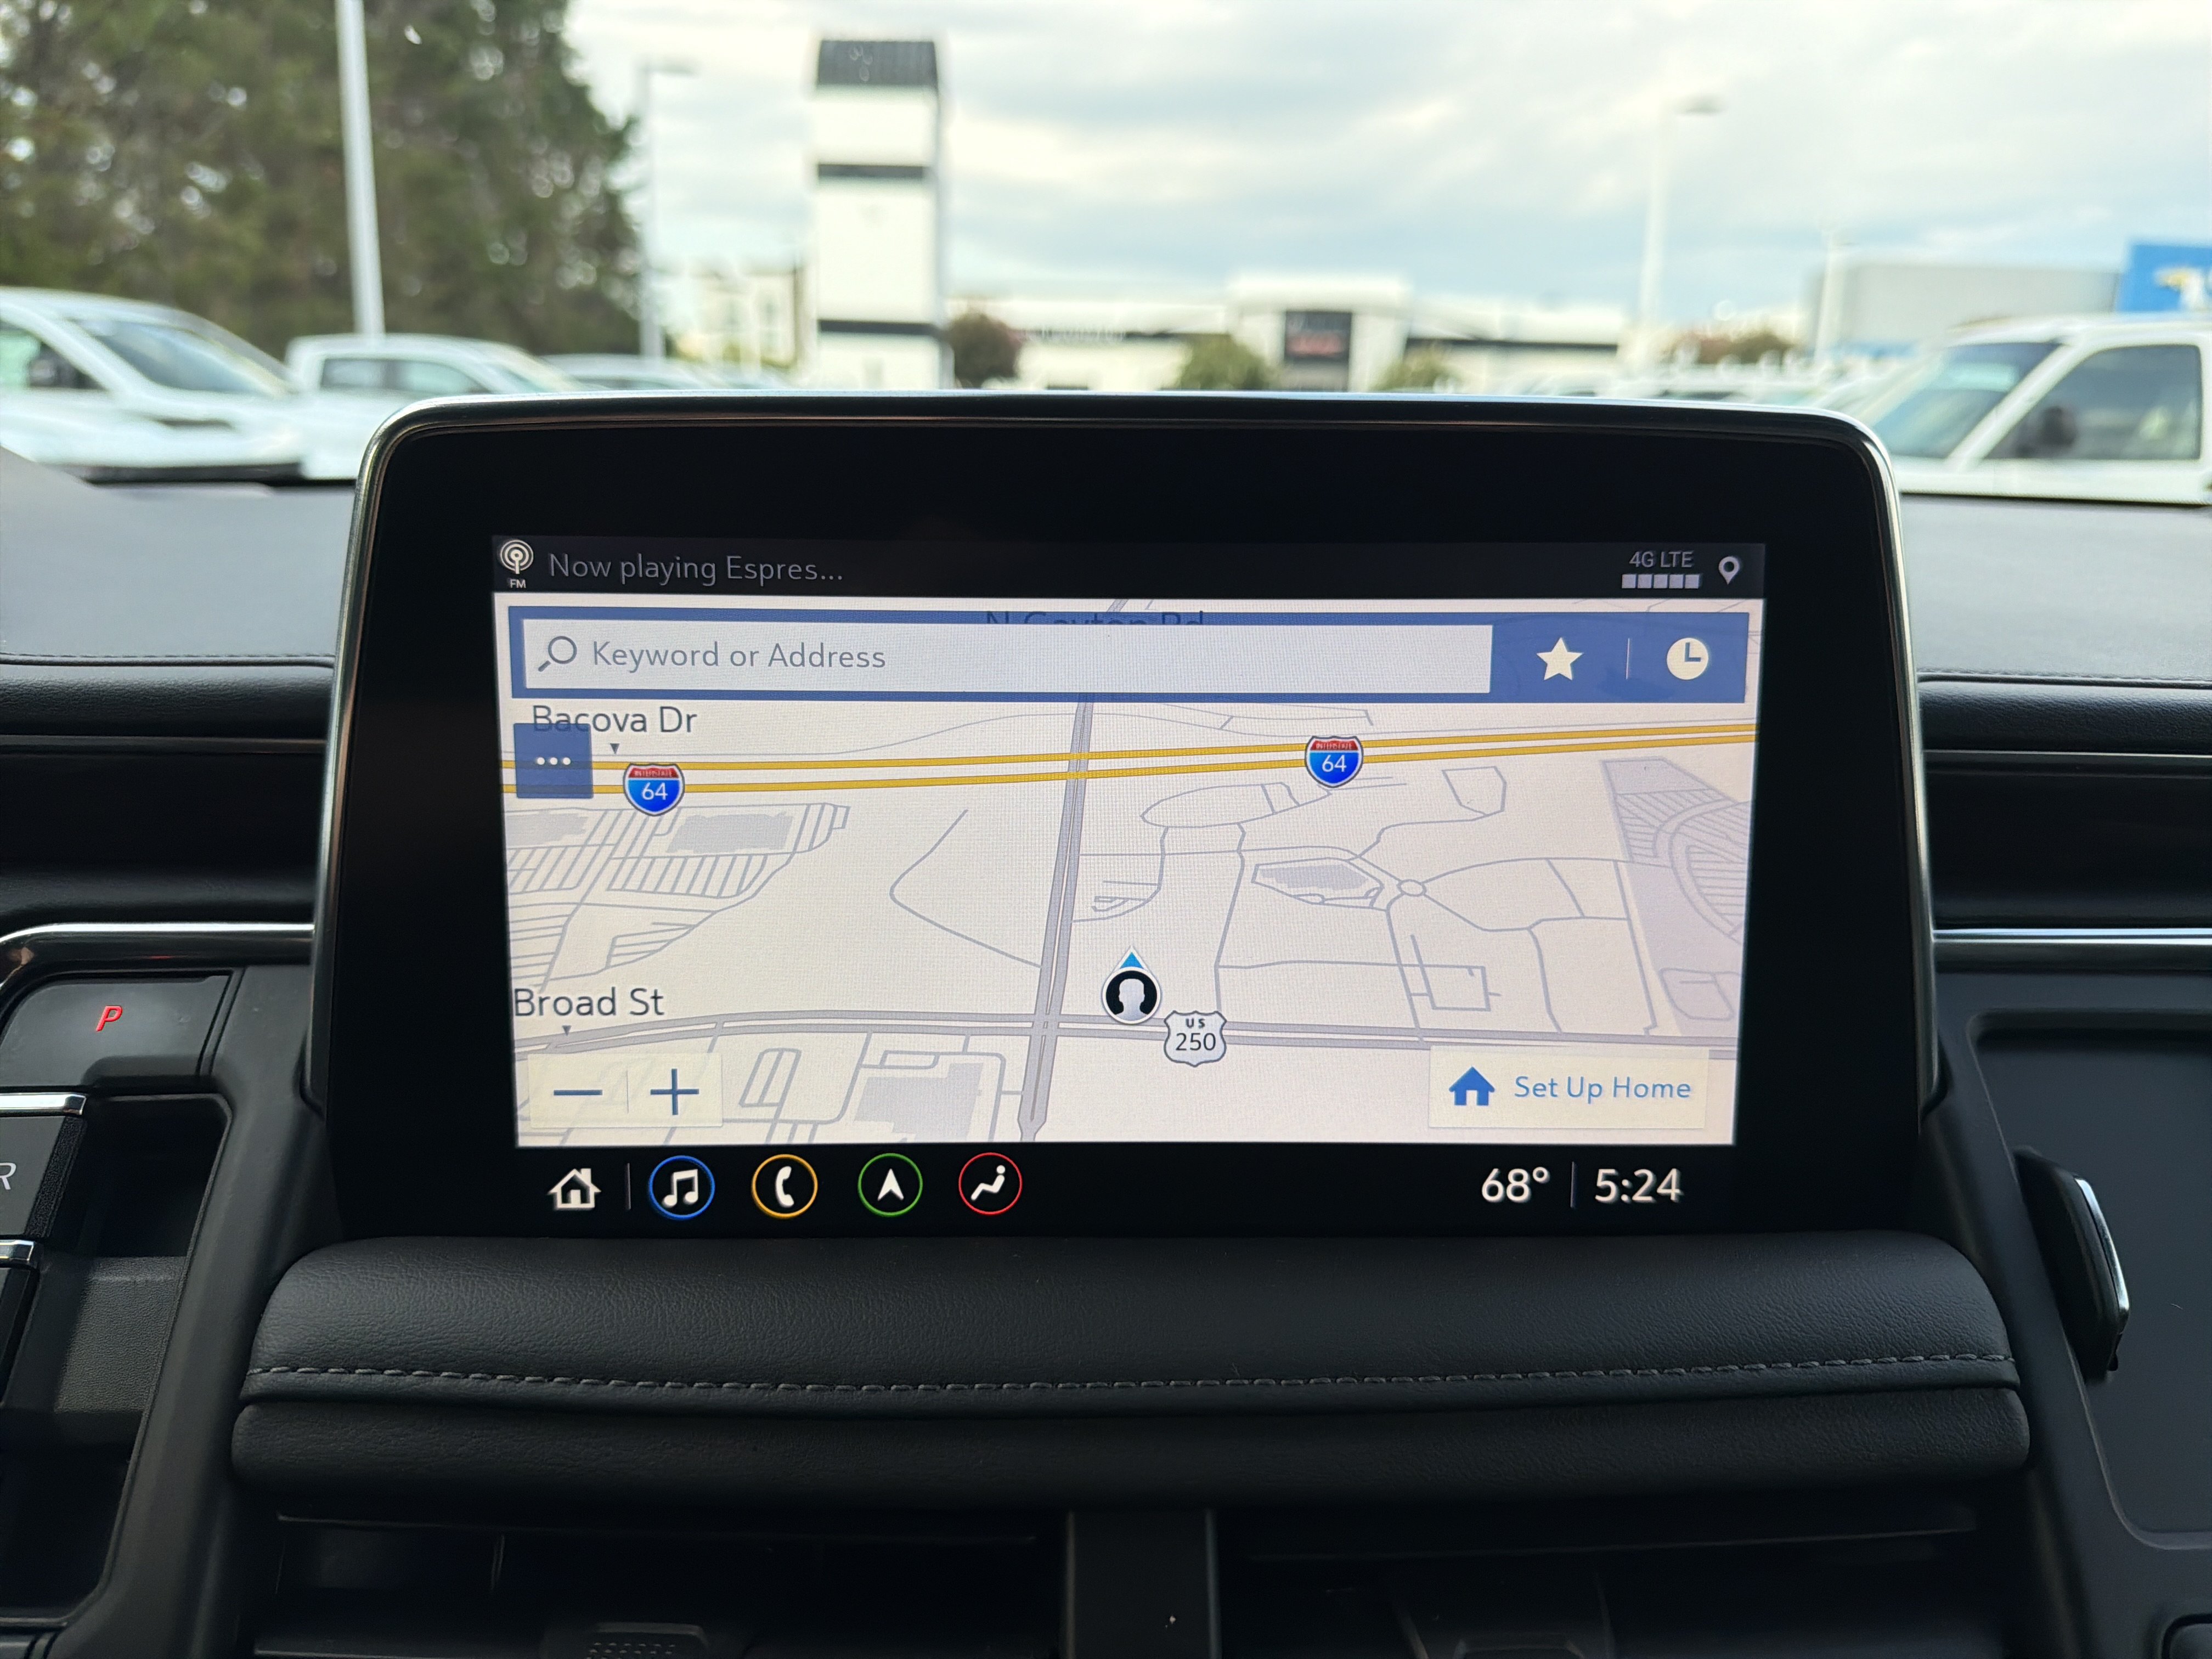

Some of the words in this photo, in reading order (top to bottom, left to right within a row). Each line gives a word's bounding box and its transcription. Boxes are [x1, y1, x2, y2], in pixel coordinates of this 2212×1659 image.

[549, 553, 611, 577] Now
[620, 552, 716, 586] playing
[727, 555, 843, 585] Espres...
[1629, 551, 1654, 568] 4G
[1660, 551, 1694, 568] LTE
[510, 579, 527, 589] FM
[593, 641, 719, 673] Keyword
[730, 647, 759, 667] or
[768, 642, 886, 668] Address
[533, 705, 647, 732] Bacova
[659, 706, 697, 732] Dr
[1322, 754, 1347, 772] 64
[641, 782, 668, 800] 64
[515, 987, 616, 1016] Broad
[630, 988, 665, 1016] St
[95, 1005, 123, 1031] P
[1175, 1032, 1216, 1051] 250
[1514, 1076, 1558, 1098] Set
[1566, 1077, 1602, 1104] Up
[1613, 1077, 1691, 1098] Home
[1481, 1166, 1550, 1203] 68°
[1594, 1167, 1684, 1203] 5:24
